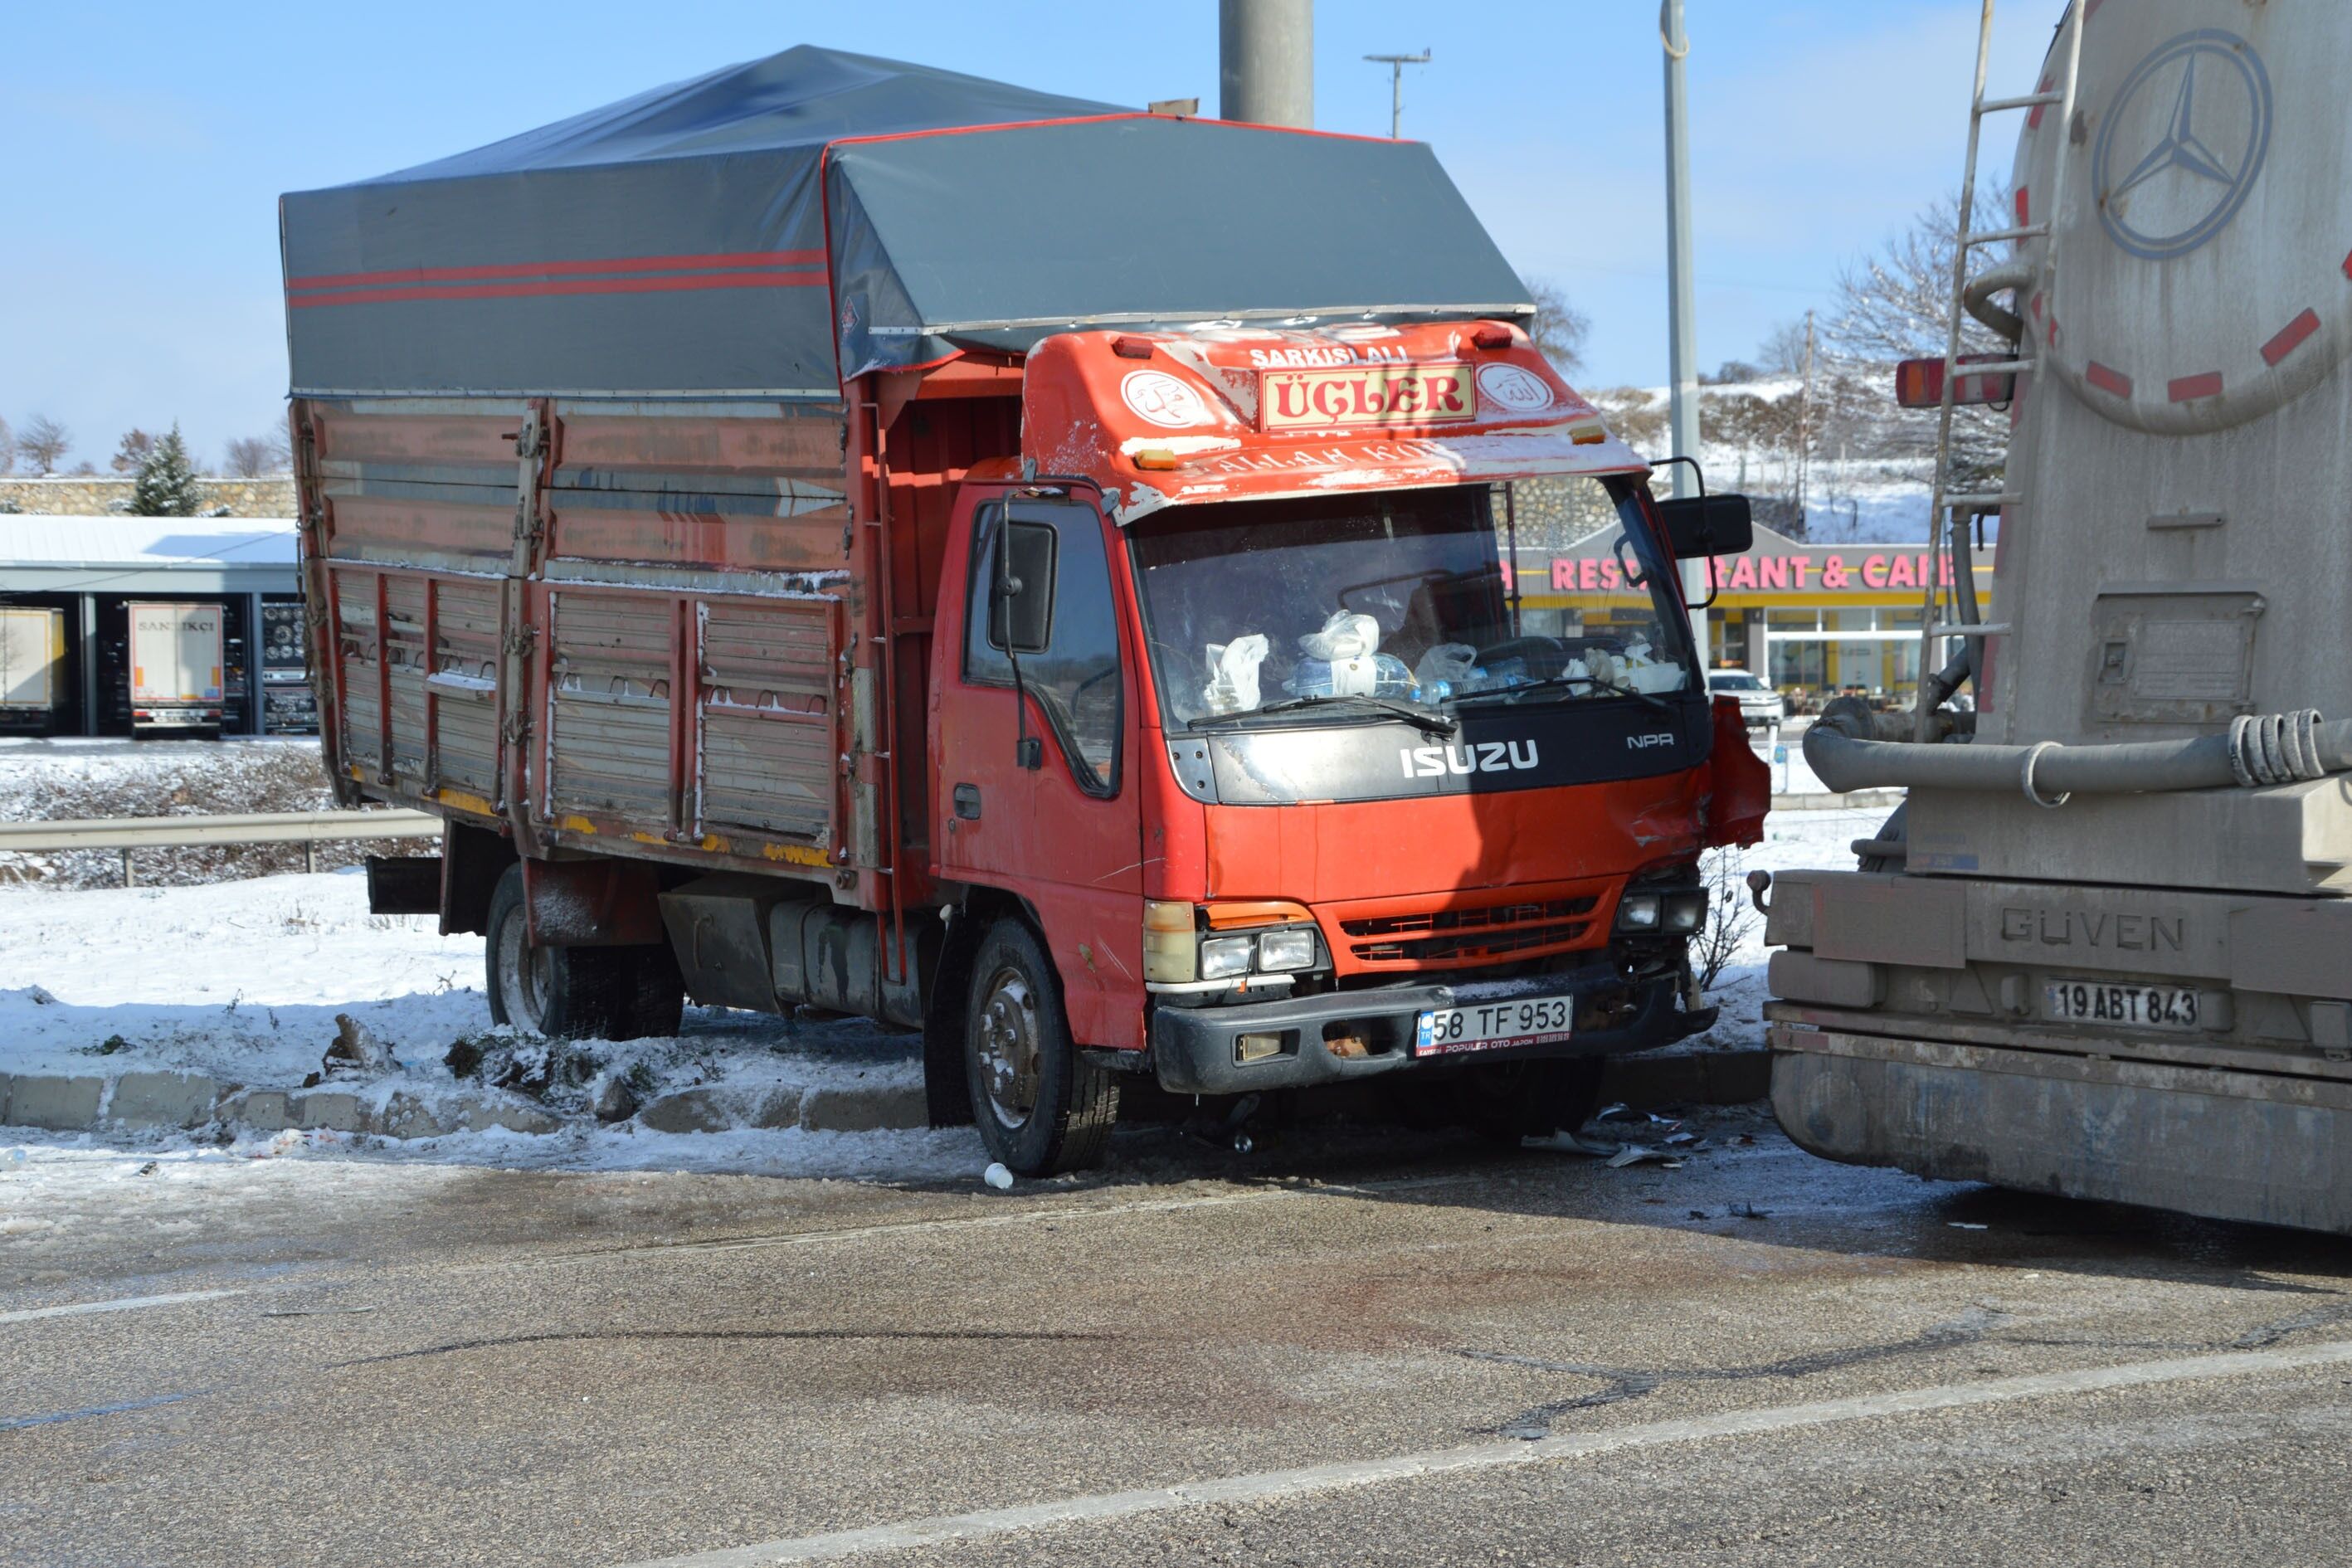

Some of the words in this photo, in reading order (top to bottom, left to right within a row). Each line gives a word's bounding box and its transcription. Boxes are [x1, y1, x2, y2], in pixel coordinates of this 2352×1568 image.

[1274, 373, 1464, 425] ÜÇLER
[1551, 554, 1810, 591] RESTRANT
[1822, 554, 1849, 589] &
[138, 621, 214, 635] SANIKÇI
[1400, 739, 1539, 779] ISUZU
[1626, 733, 1675, 749] NPR
[2000, 908, 2184, 952] GÜVEN
[1434, 1012, 1464, 1041] 58
[1478, 1006, 1513, 1035] TF
[1519, 1001, 1566, 1030] 953
[2059, 985, 2088, 1017] 19
[2093, 987, 2140, 1021] ABT
[2147, 987, 2197, 1025] 843
[1421, 1030, 1431, 1040] TR
[1491, 1040, 1510, 1049] OTO
